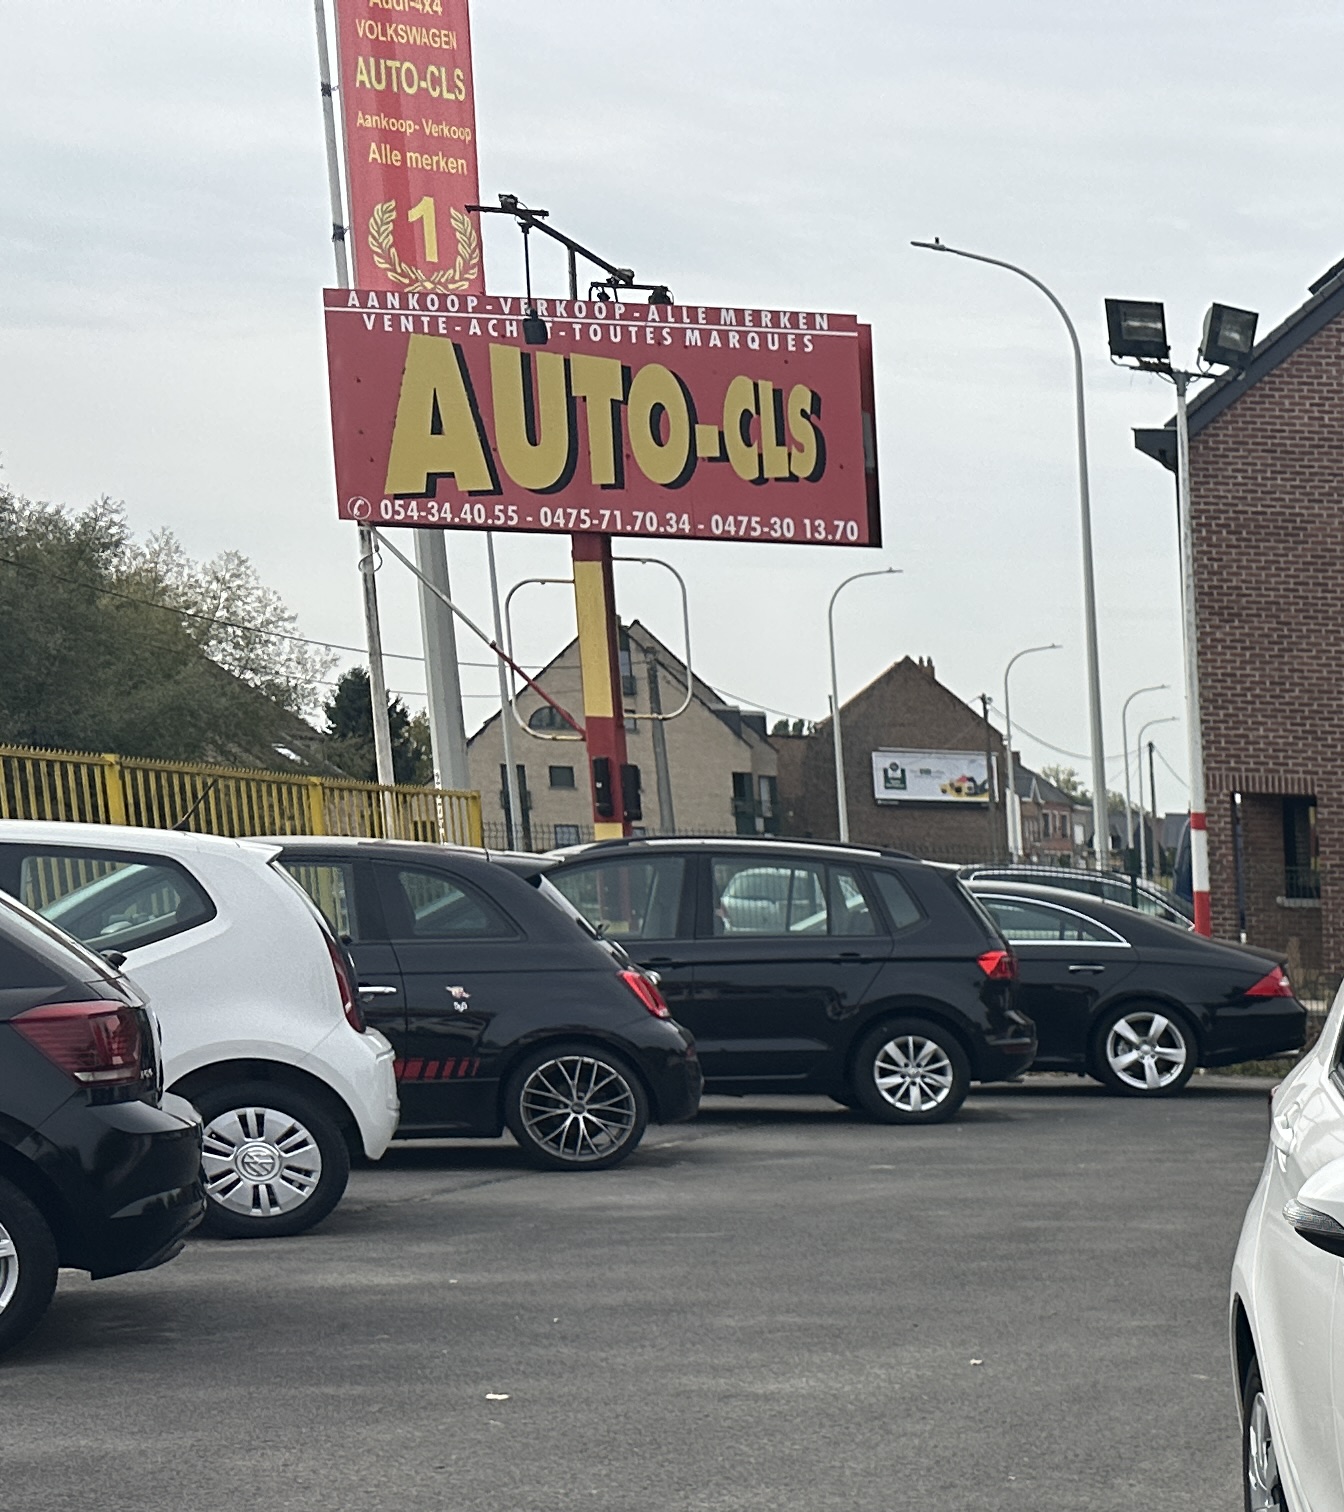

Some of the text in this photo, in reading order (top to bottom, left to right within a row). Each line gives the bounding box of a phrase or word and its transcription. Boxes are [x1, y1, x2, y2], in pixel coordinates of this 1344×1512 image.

[355, 18, 457, 50] VOLKSWAGEN
[355, 56, 466, 101] AUTO-CLS
[421, 117, 472, 143] Verkoop
[368, 142, 468, 176] Alle merken
[407, 195, 438, 263] 1
[719, 308, 829, 331] MERKEN
[685, 329, 814, 353] MARQUES
[384, 333, 822, 495] AUTO-CLS
[380, 499, 519, 525] 054-34.40.55
[539, 506, 690, 534] 0475-71.70.34
